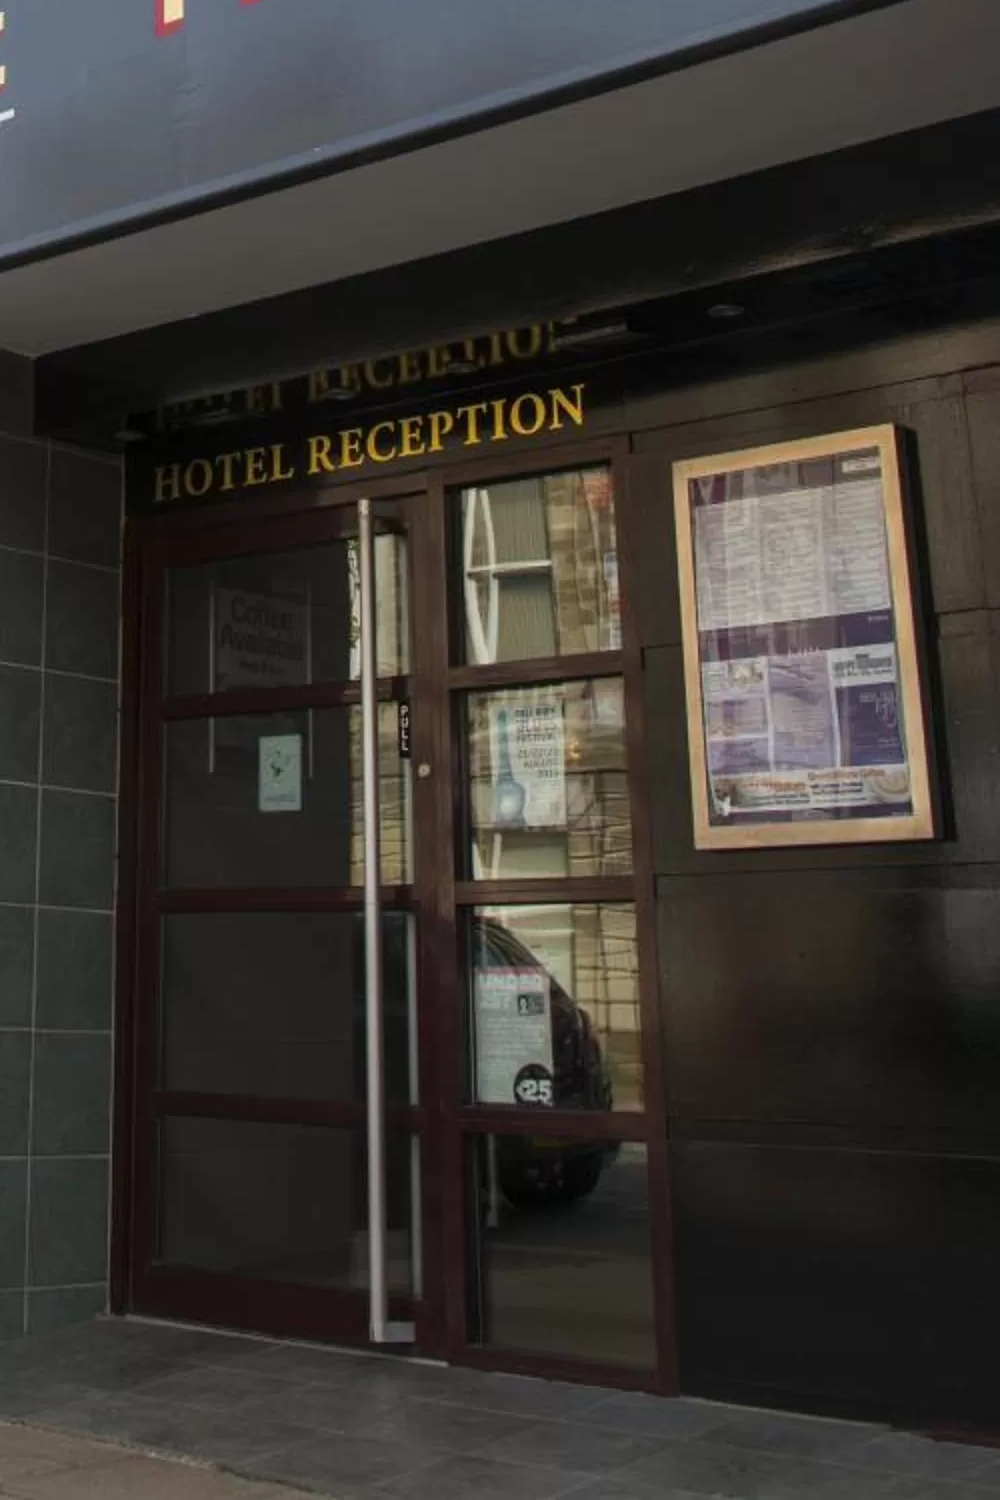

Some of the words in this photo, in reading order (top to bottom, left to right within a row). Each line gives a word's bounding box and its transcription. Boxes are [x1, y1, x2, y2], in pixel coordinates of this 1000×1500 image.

[152, 443, 295, 502] HOTEL
[306, 384, 586, 476] RECEPTION
[400, 705, 409, 752] PULL
